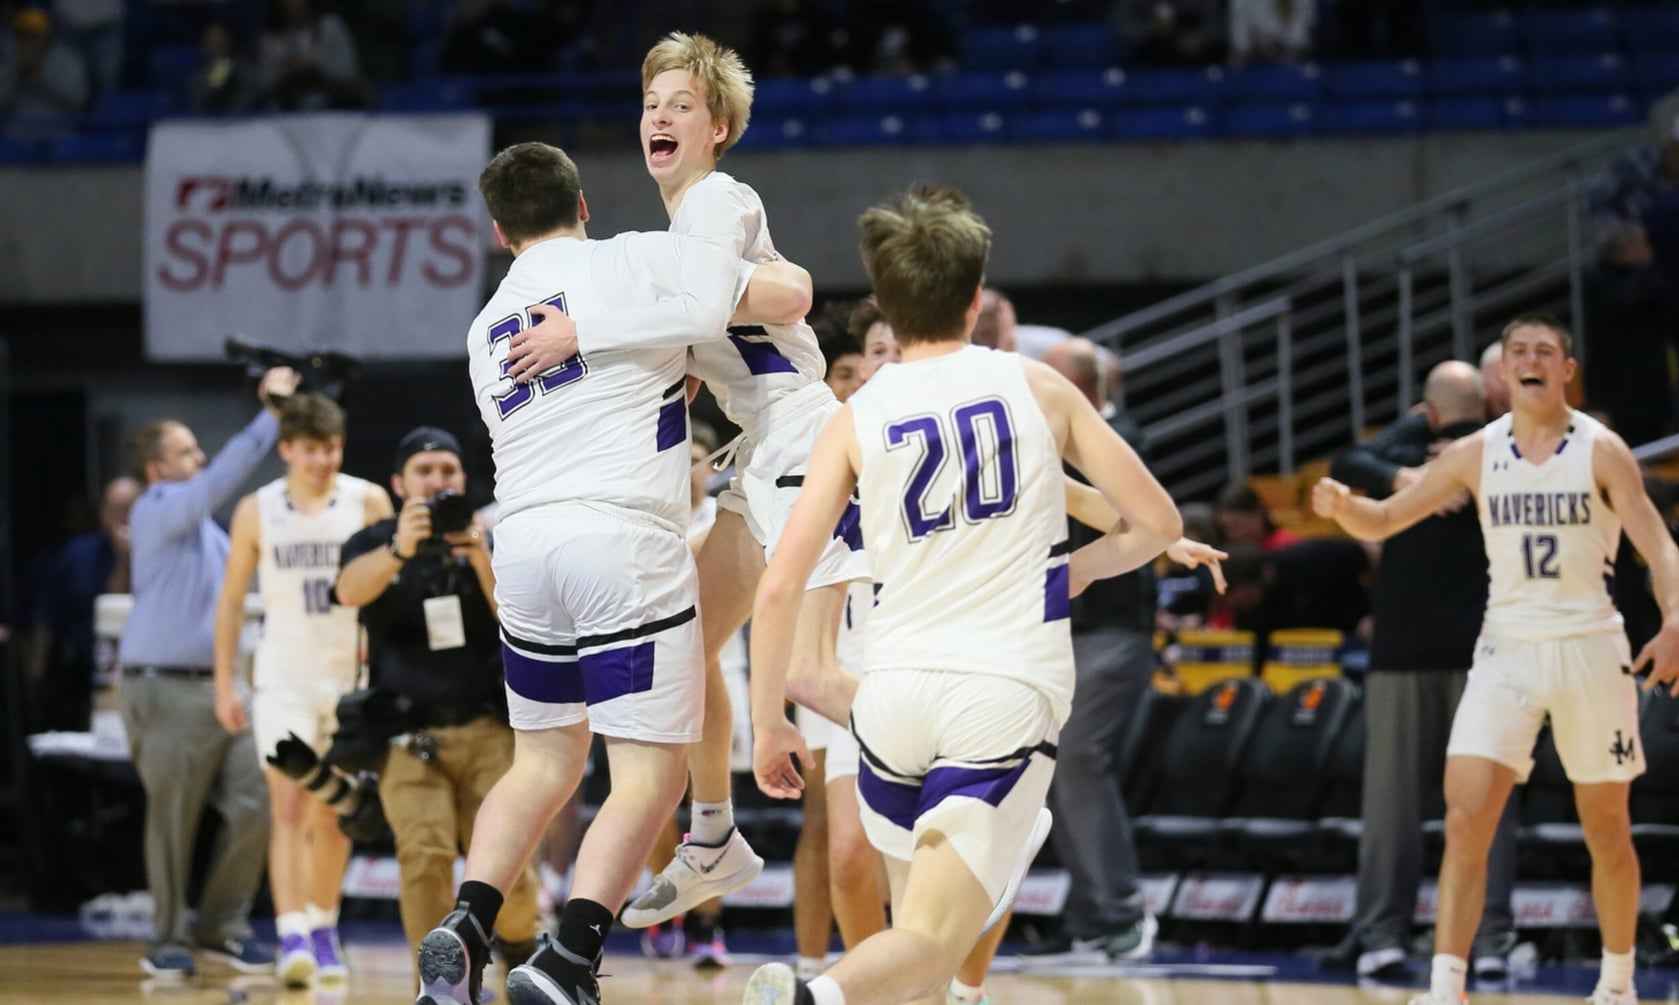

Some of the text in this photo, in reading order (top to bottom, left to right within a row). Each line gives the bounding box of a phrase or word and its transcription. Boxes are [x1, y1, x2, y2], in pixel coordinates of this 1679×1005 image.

[233, 178, 466, 210] MetroNews
[158, 216, 476, 292] SPORTS
[882, 394, 1021, 544] 20
[1488, 492, 1591, 526] MAVERICKS
[273, 542, 341, 569] MAVERIC
[1522, 534, 1561, 579] 12
[303, 578, 332, 615] 10
